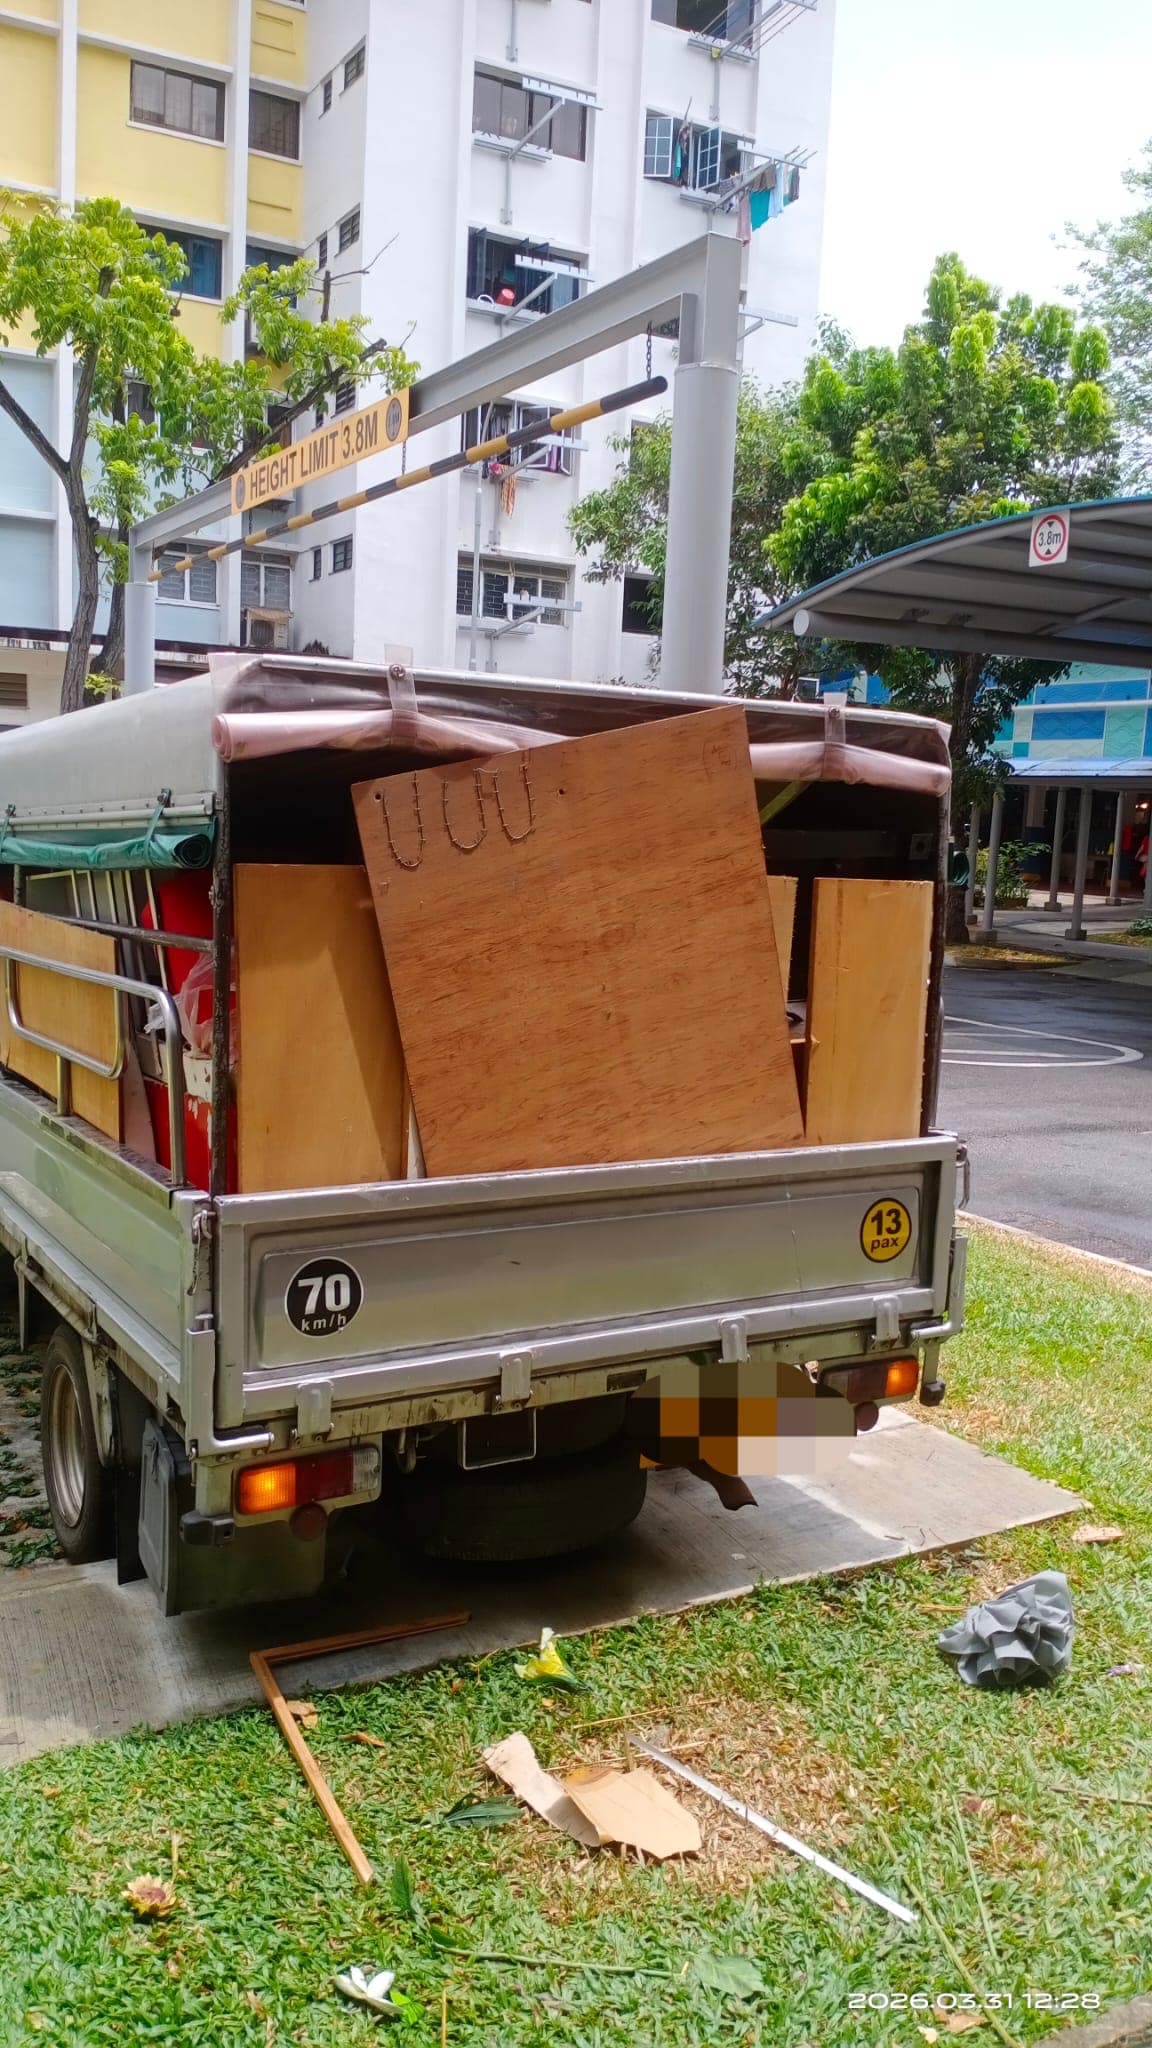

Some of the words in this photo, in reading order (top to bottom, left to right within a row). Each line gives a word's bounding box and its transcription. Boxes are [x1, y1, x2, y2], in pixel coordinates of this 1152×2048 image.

[250, 451, 296, 501] HEIGHT
[300, 430, 338, 477] LIMIT
[342, 410, 378, 460] 3.8M
[1038, 531, 1061, 547] 3.8m
[871, 1208, 902, 1236] 13
[870, 1237, 899, 1253] pax
[298, 1273, 350, 1315] 70
